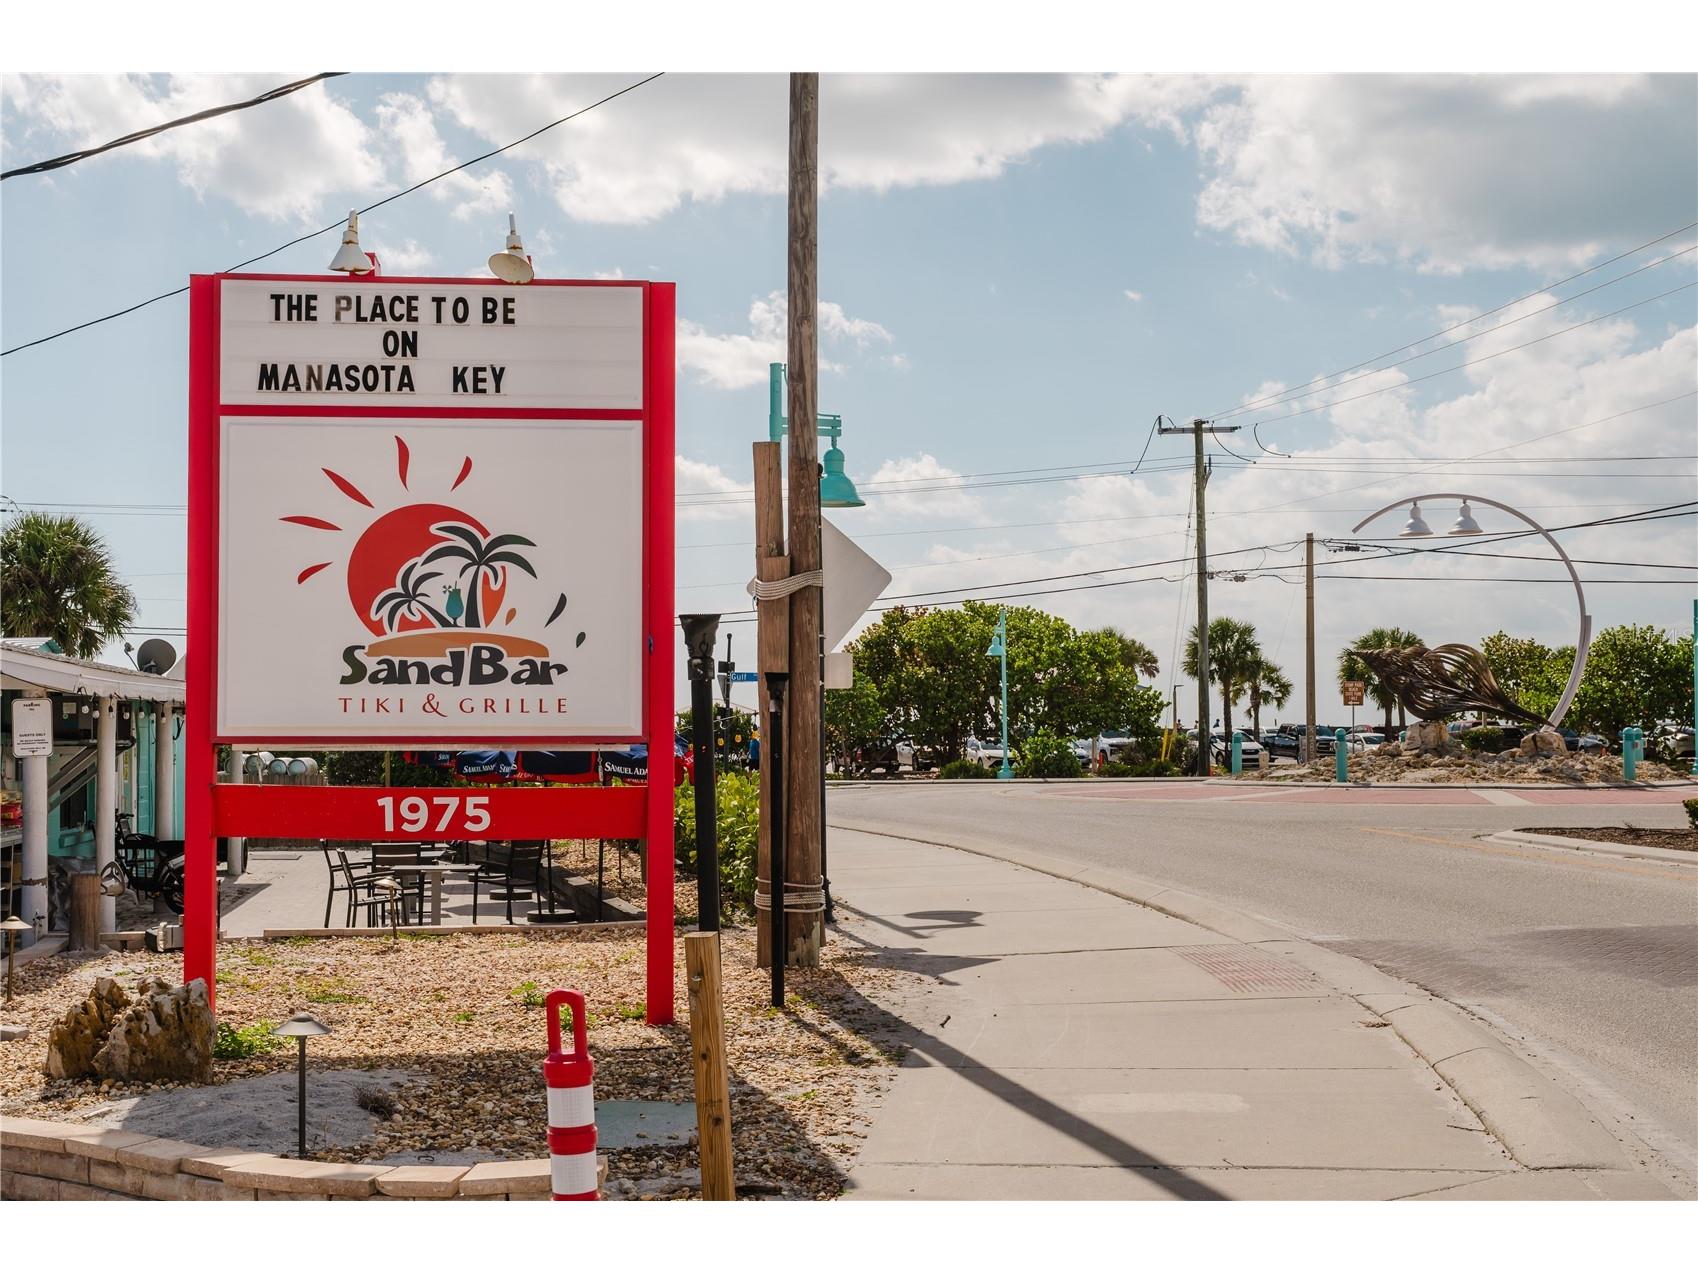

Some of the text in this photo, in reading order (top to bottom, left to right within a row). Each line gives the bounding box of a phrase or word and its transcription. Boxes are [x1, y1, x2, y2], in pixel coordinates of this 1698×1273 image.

[270, 294, 516, 324] THE PLACE TO BE
[383, 330, 418, 357] ON
[257, 363, 506, 394] MANASOTA KEY
[340, 646, 568, 686] SandBar
[338, 694, 568, 717] TIKI & GRILLE
[604, 761, 633, 775] SAMUEL
[378, 797, 490, 831] 1975
